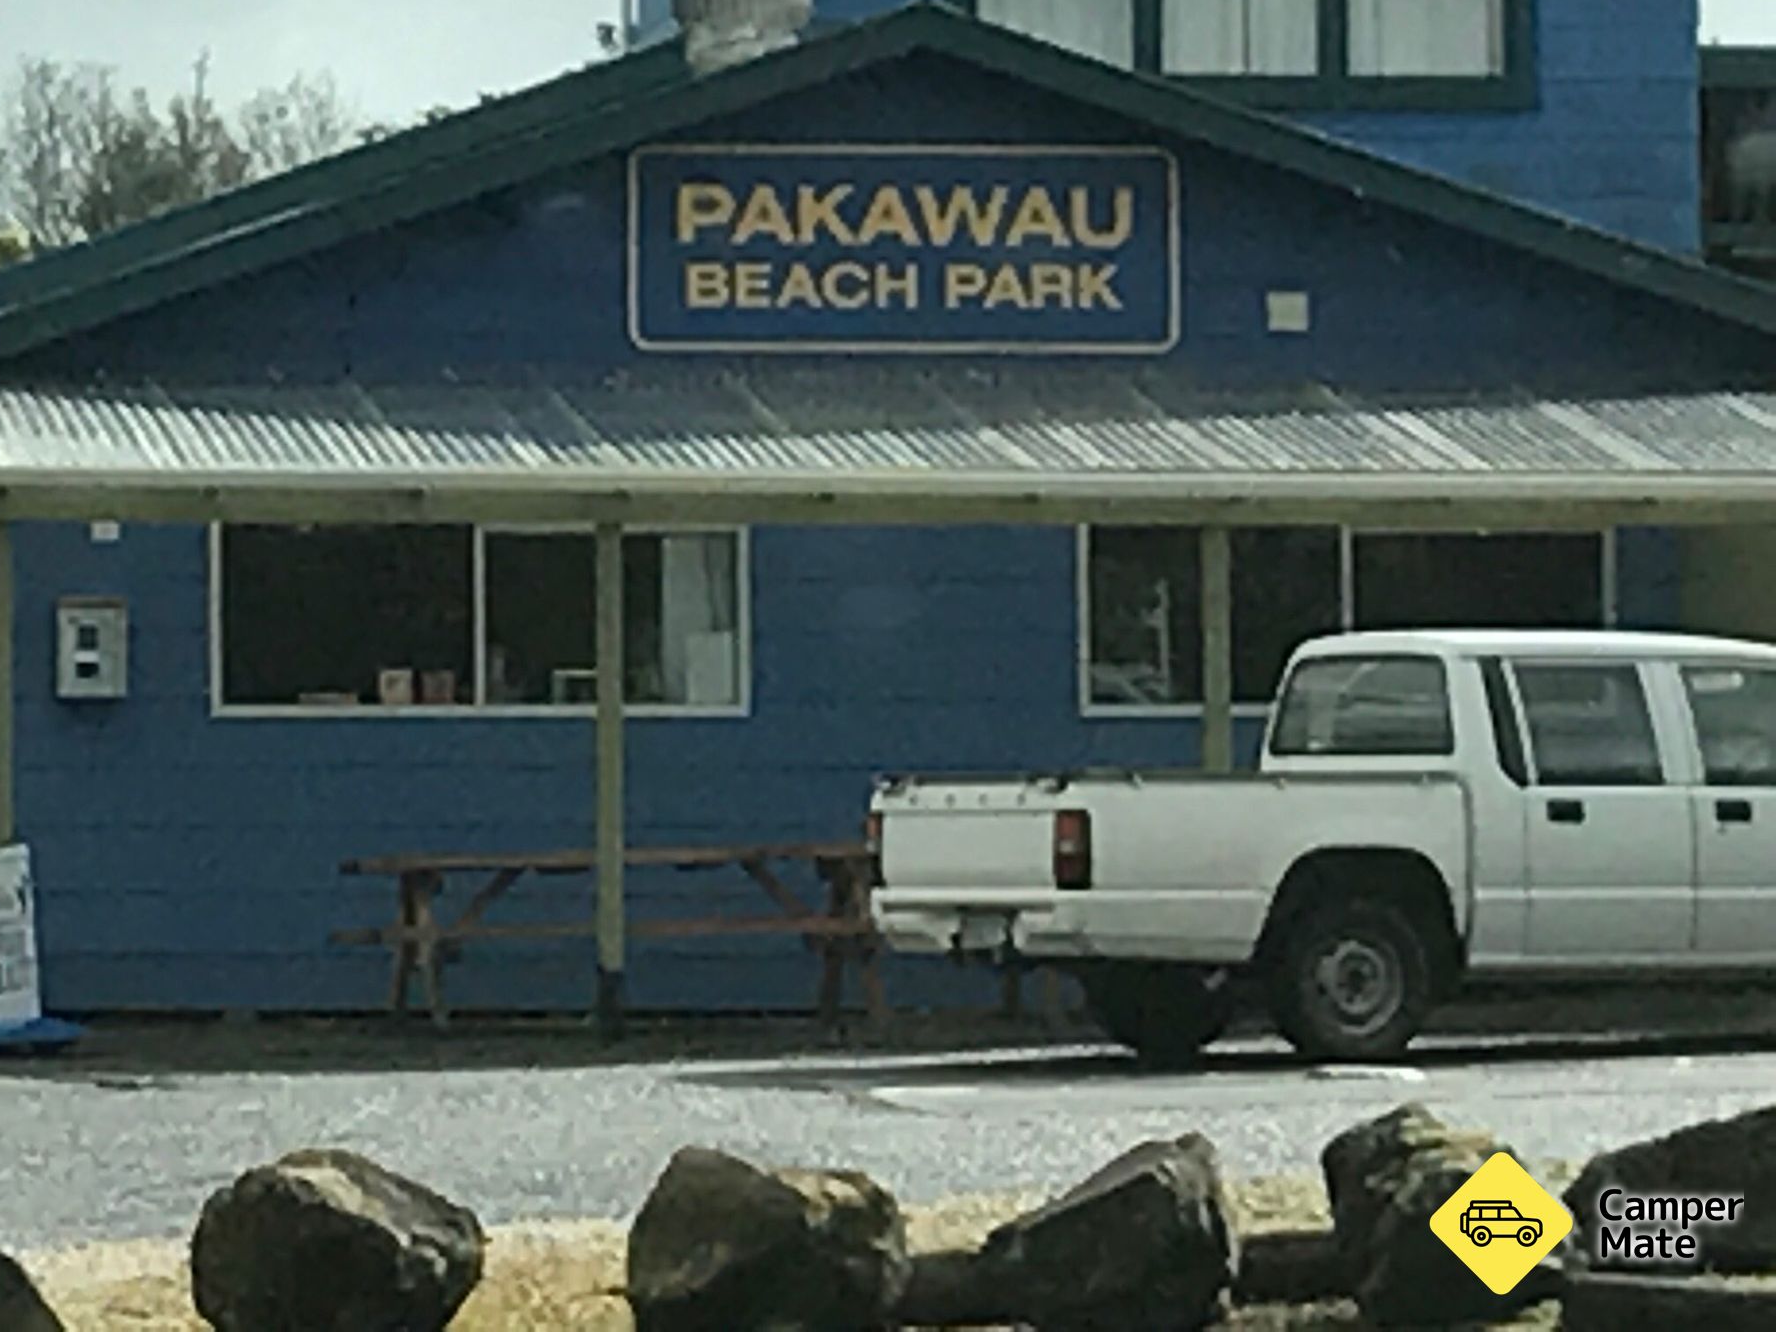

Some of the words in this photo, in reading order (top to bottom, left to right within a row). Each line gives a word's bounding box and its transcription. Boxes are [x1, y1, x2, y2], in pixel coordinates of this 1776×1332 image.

[676, 182, 1133, 249] PAKAWAU
[684, 262, 919, 309] BEACH
[944, 262, 1122, 309] PARK
